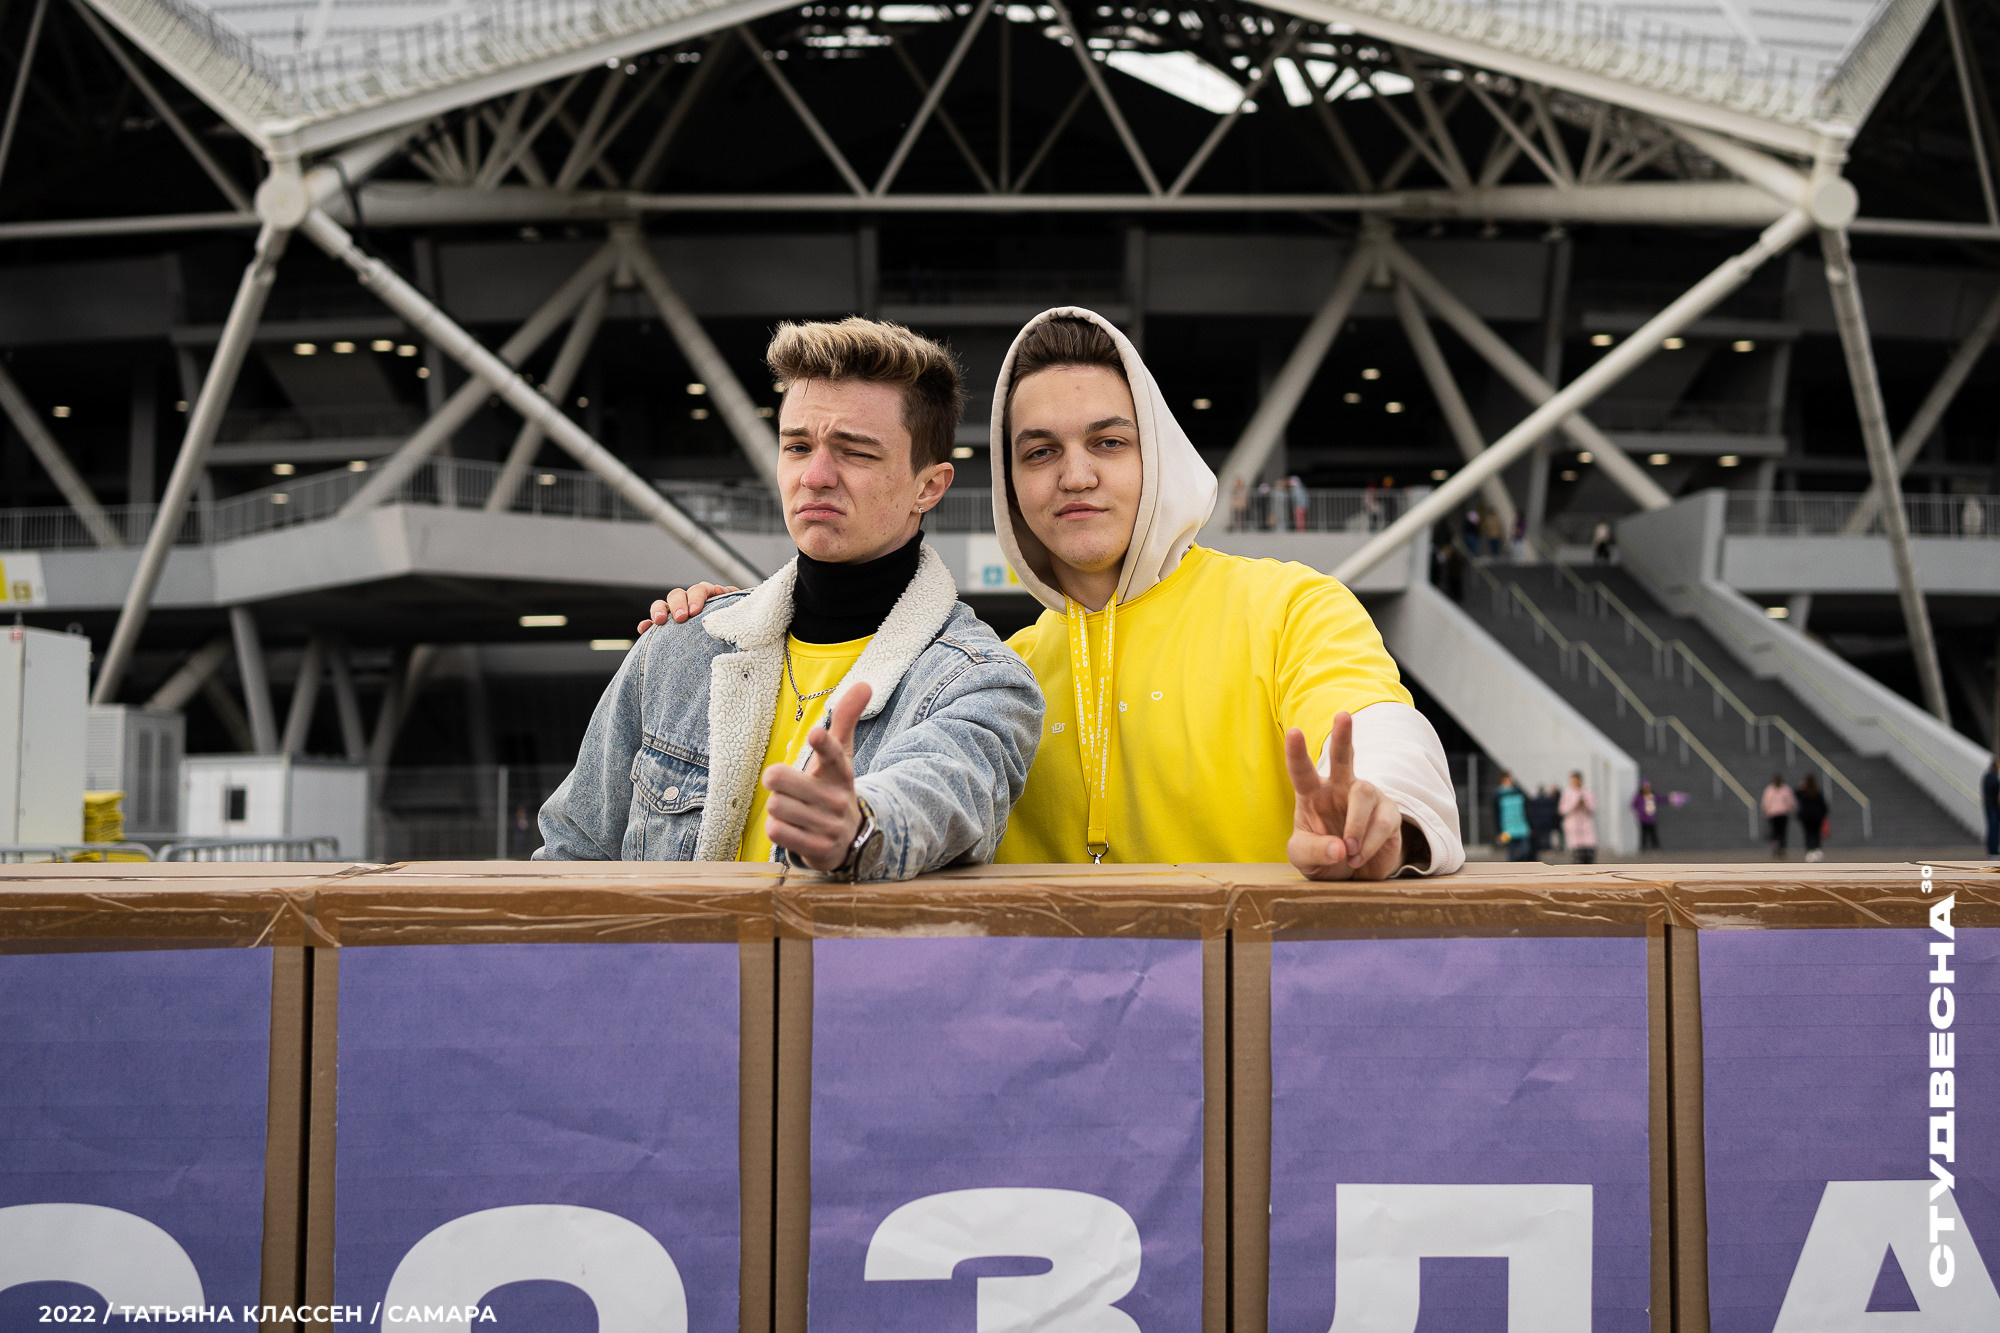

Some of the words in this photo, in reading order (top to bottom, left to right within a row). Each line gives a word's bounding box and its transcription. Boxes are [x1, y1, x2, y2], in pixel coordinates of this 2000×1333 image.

[1078, 610, 1088, 667] СТУДВЕСНА
[1076, 682, 1087, 745] СТУДВЕСНА
[1100, 728, 1109, 791] СТУДВЕСНА
